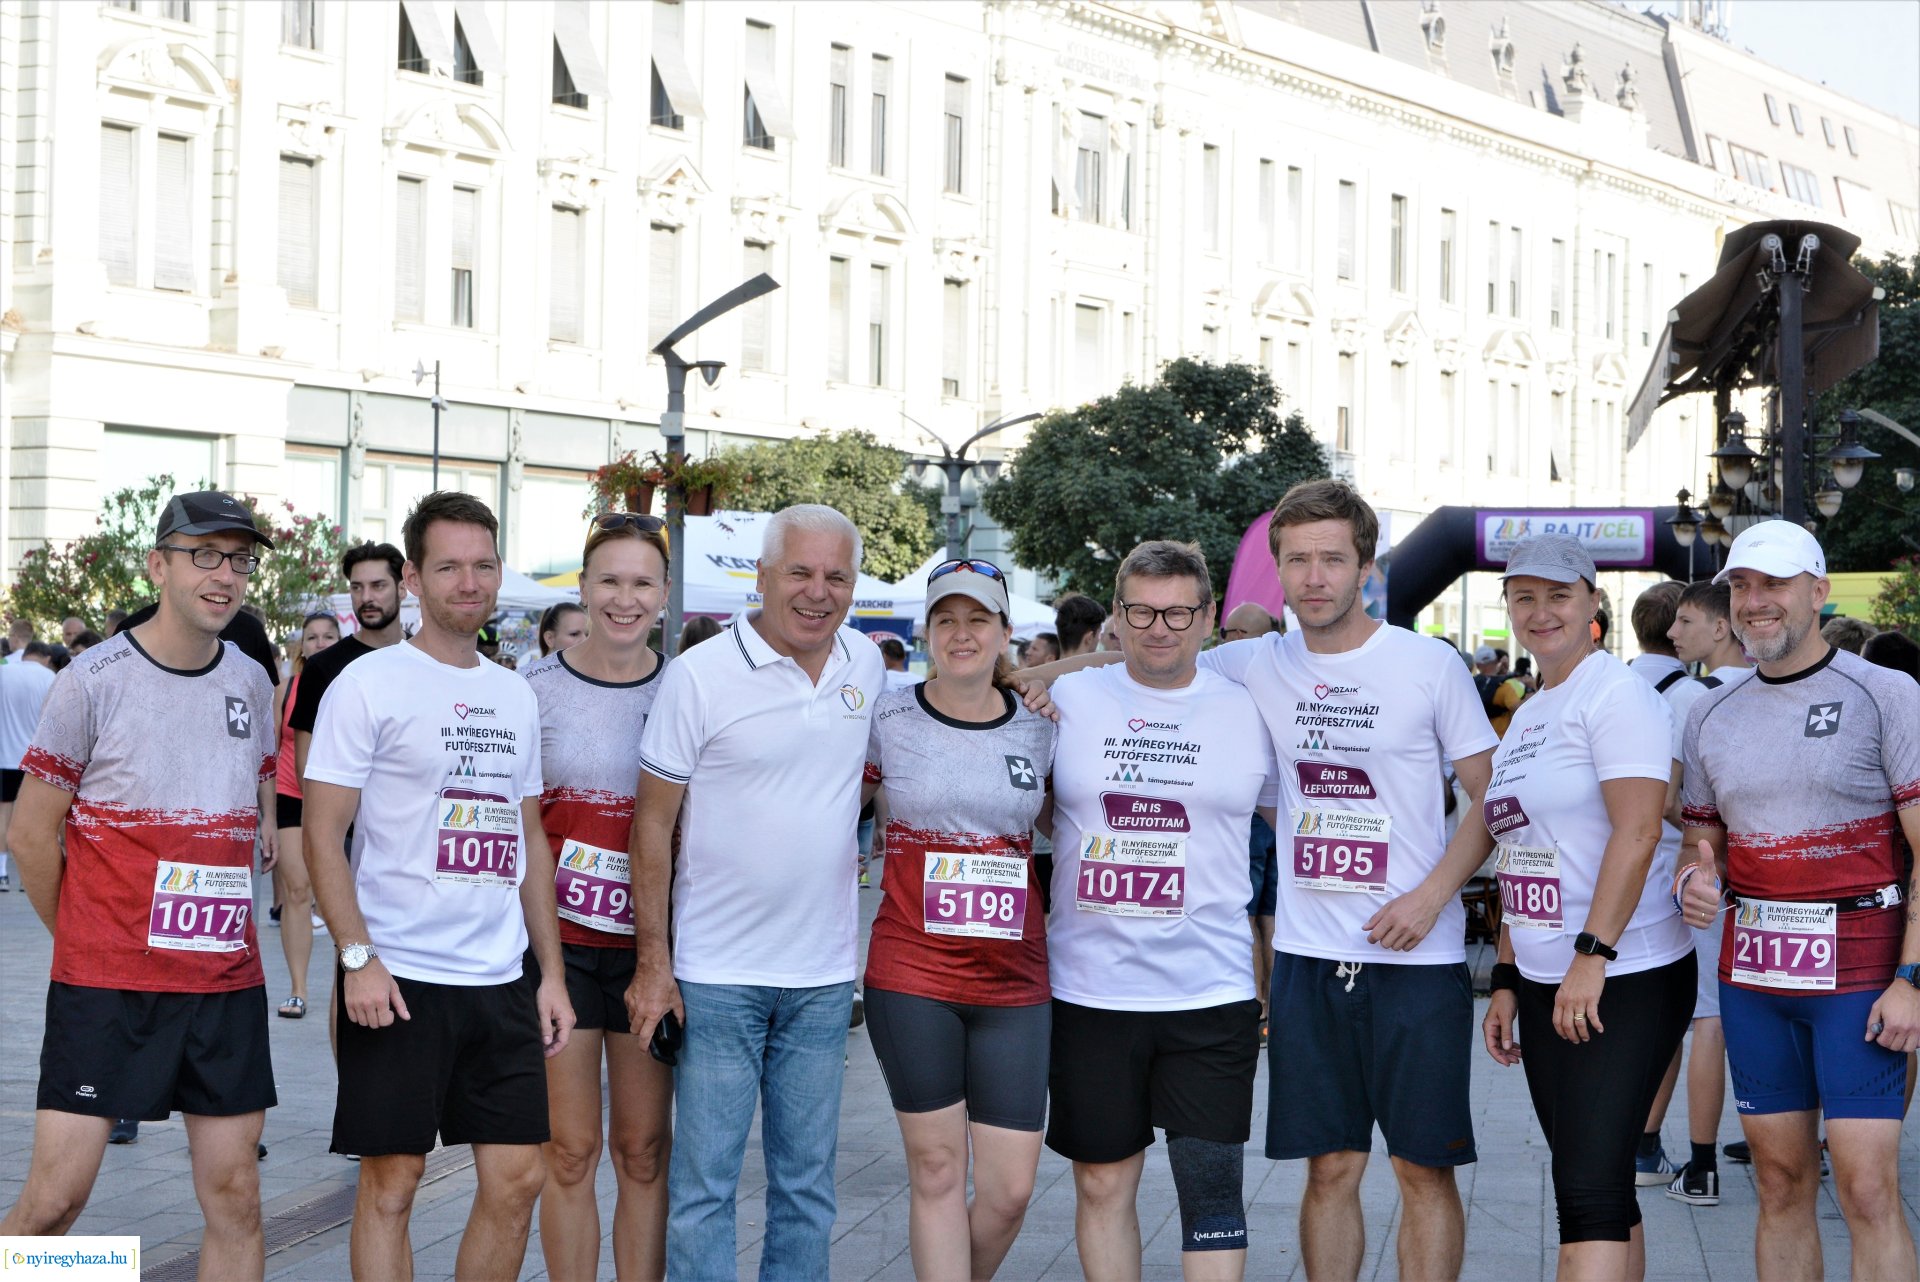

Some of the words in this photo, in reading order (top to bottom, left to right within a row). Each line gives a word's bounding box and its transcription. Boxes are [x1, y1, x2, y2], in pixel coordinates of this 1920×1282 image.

[469, 707, 496, 716] MOZAIK
[1296, 702, 1308, 712] III.
[1310, 702, 1380, 716] NYÍREGYHÁZI
[1146, 722, 1180, 731] MOZAIK
[1296, 714, 1375, 729] FUTÓFESZTIVÁL
[441, 727, 454, 737] III.
[457, 725, 516, 741] NYÍREGYHÁZI
[445, 739, 517, 756] FUTÓFESZTIVÁL
[1104, 738, 1118, 746] III.
[1122, 737, 1201, 753] NYÍREGYHÁZI
[1104, 750, 1198, 765] FUTÓFESZTIVÁL
[1148, 776, 1194, 786] támogatásával
[1320, 768, 1335, 780] ÉN
[1338, 770, 1348, 780] IS
[1304, 784, 1370, 794] LEFUTOTTAM
[1132, 801, 1148, 812] ÉN
[1150, 803, 1162, 812] IS
[1493, 804, 1501, 816] ÉN
[1502, 802, 1508, 813] IS
[1112, 816, 1184, 828] LEFUTOTTAM
[1326, 822, 1382, 832] FUTÓFESZTIVÁL
[442, 836, 517, 870] 10175
[1122, 848, 1178, 857] FUTÓFESZTIVÁL
[1302, 843, 1373, 876] 5195
[972, 868, 1022, 878] FUTÓFESZTIVÁL
[204, 878, 248, 888] FUTÓFESZTIVÁL
[1084, 868, 1182, 900] 10174
[1500, 880, 1558, 913] 10180
[938, 888, 1014, 922] 5198
[159, 900, 248, 934] 10179
[1768, 914, 1826, 924] FUTÓFESZTIVÁL
[1737, 932, 1832, 968] 21179
[1198, 1230, 1244, 1239] MUELLER
